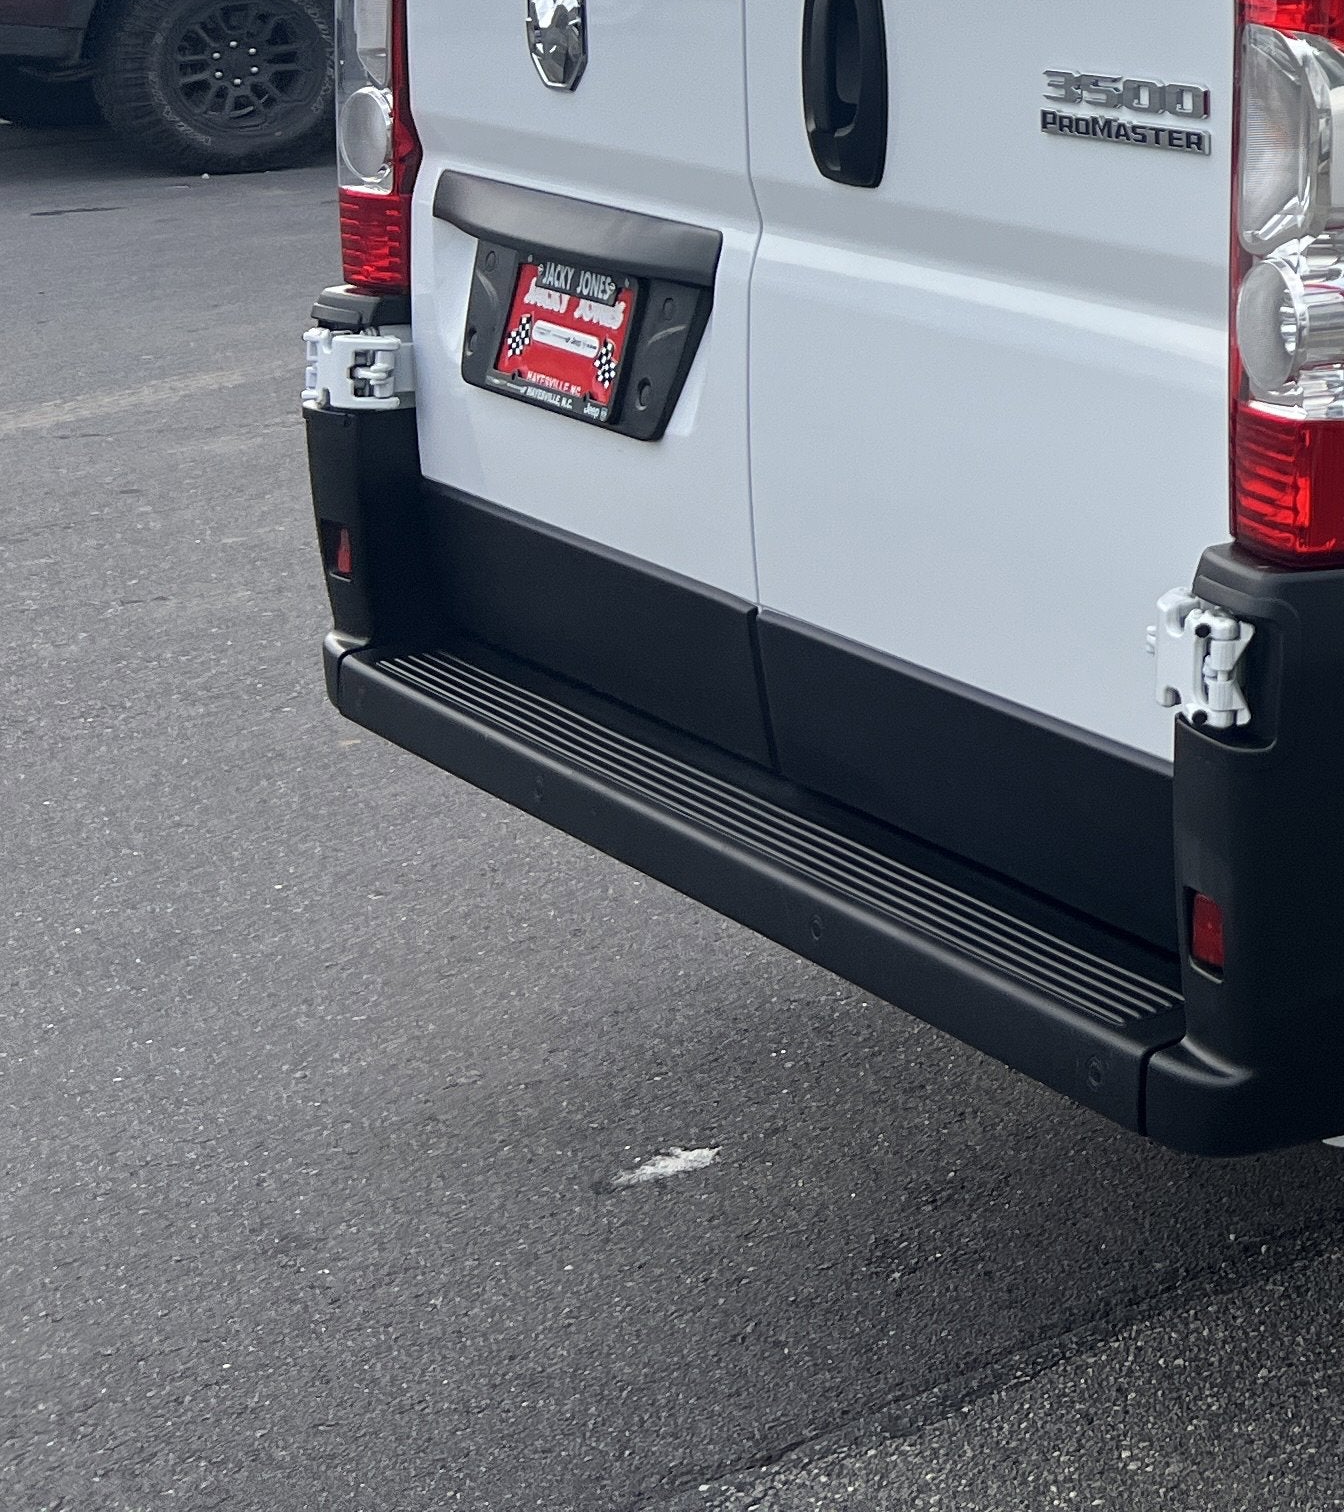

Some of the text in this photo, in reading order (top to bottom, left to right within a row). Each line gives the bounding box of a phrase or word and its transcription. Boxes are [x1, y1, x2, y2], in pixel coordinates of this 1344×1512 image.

[1042, 69, 1210, 119] 3500
[542, 261, 612, 301] JACKY JONES
[583, 402, 600, 420] Jeep
